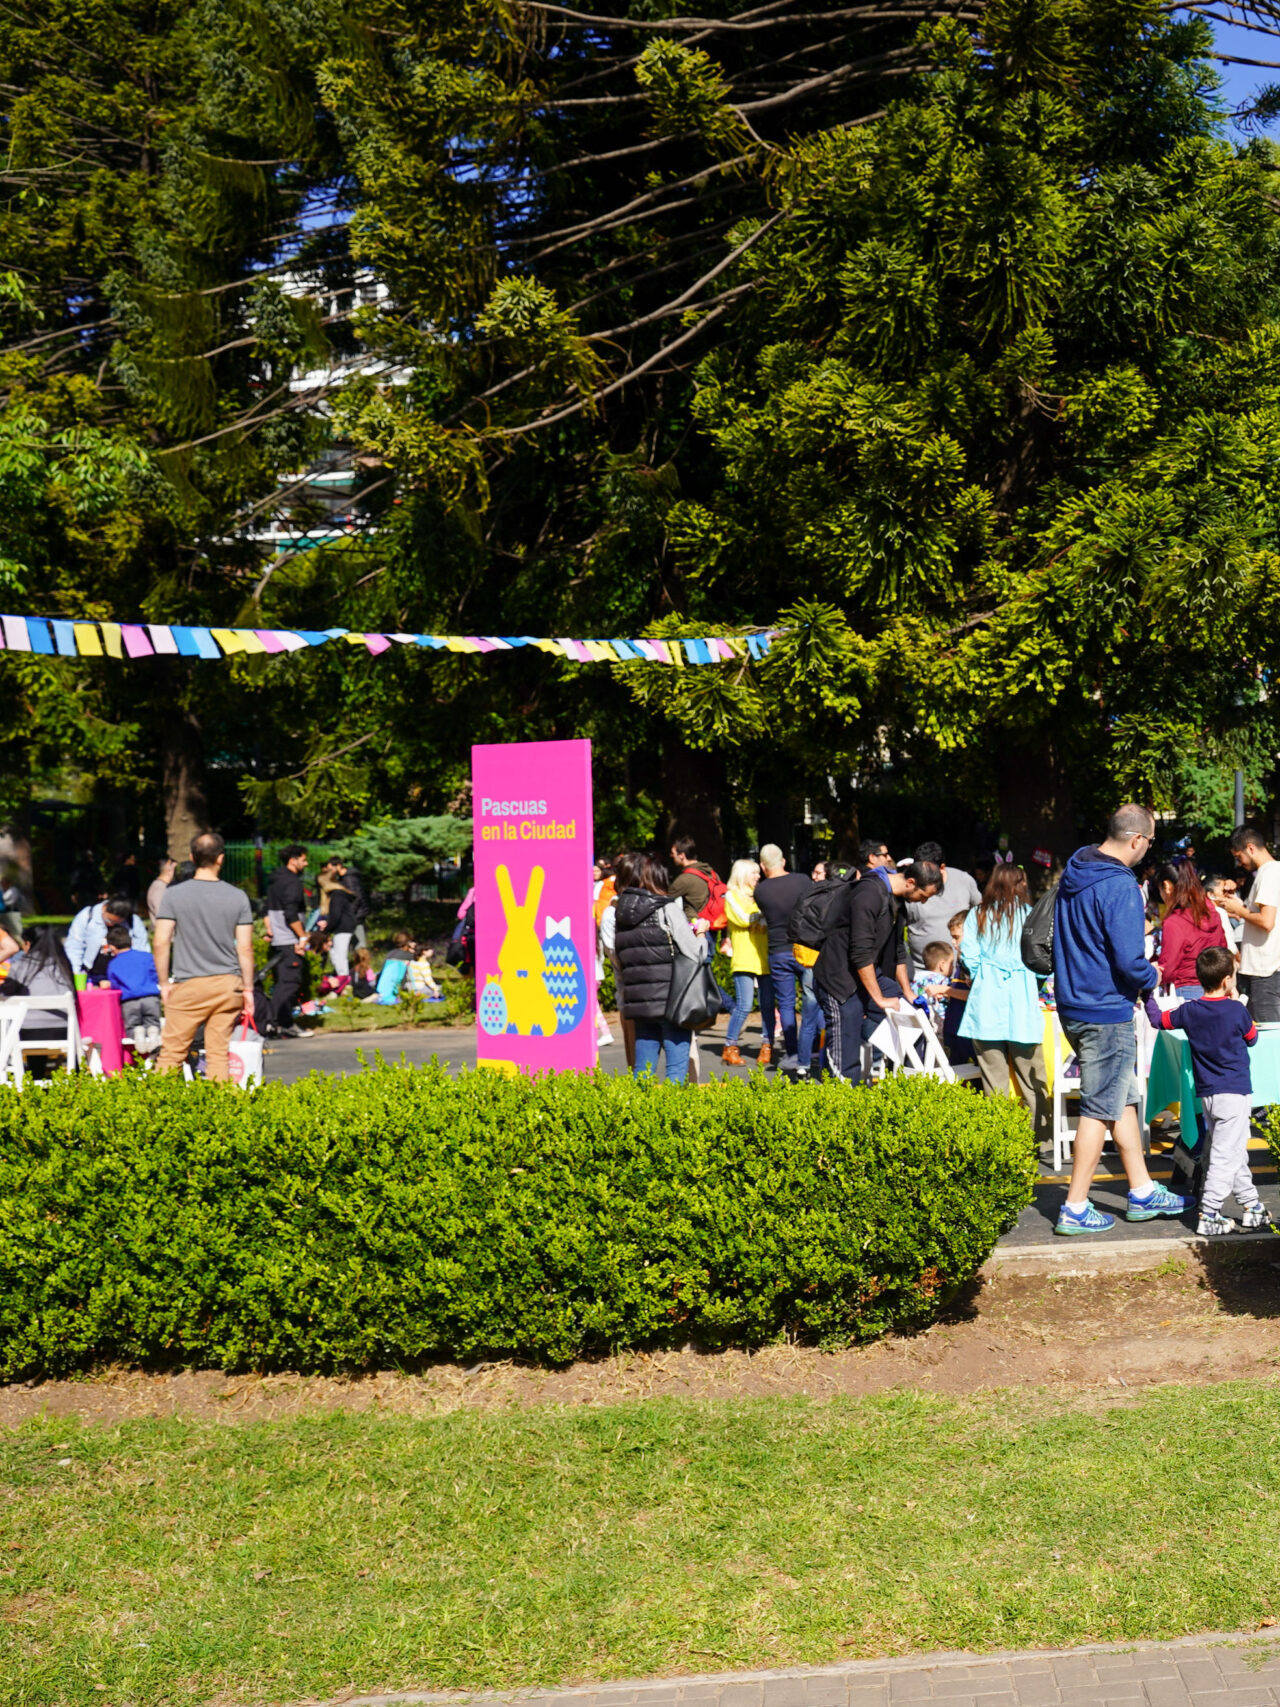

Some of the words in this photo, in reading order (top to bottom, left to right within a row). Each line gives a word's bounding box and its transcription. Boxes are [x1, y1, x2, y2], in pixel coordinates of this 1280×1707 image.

[481, 798, 547, 816] Pascuas
[481, 825, 500, 840] en
[503, 820, 518, 840] la
[520, 819, 576, 840] Ciudad
